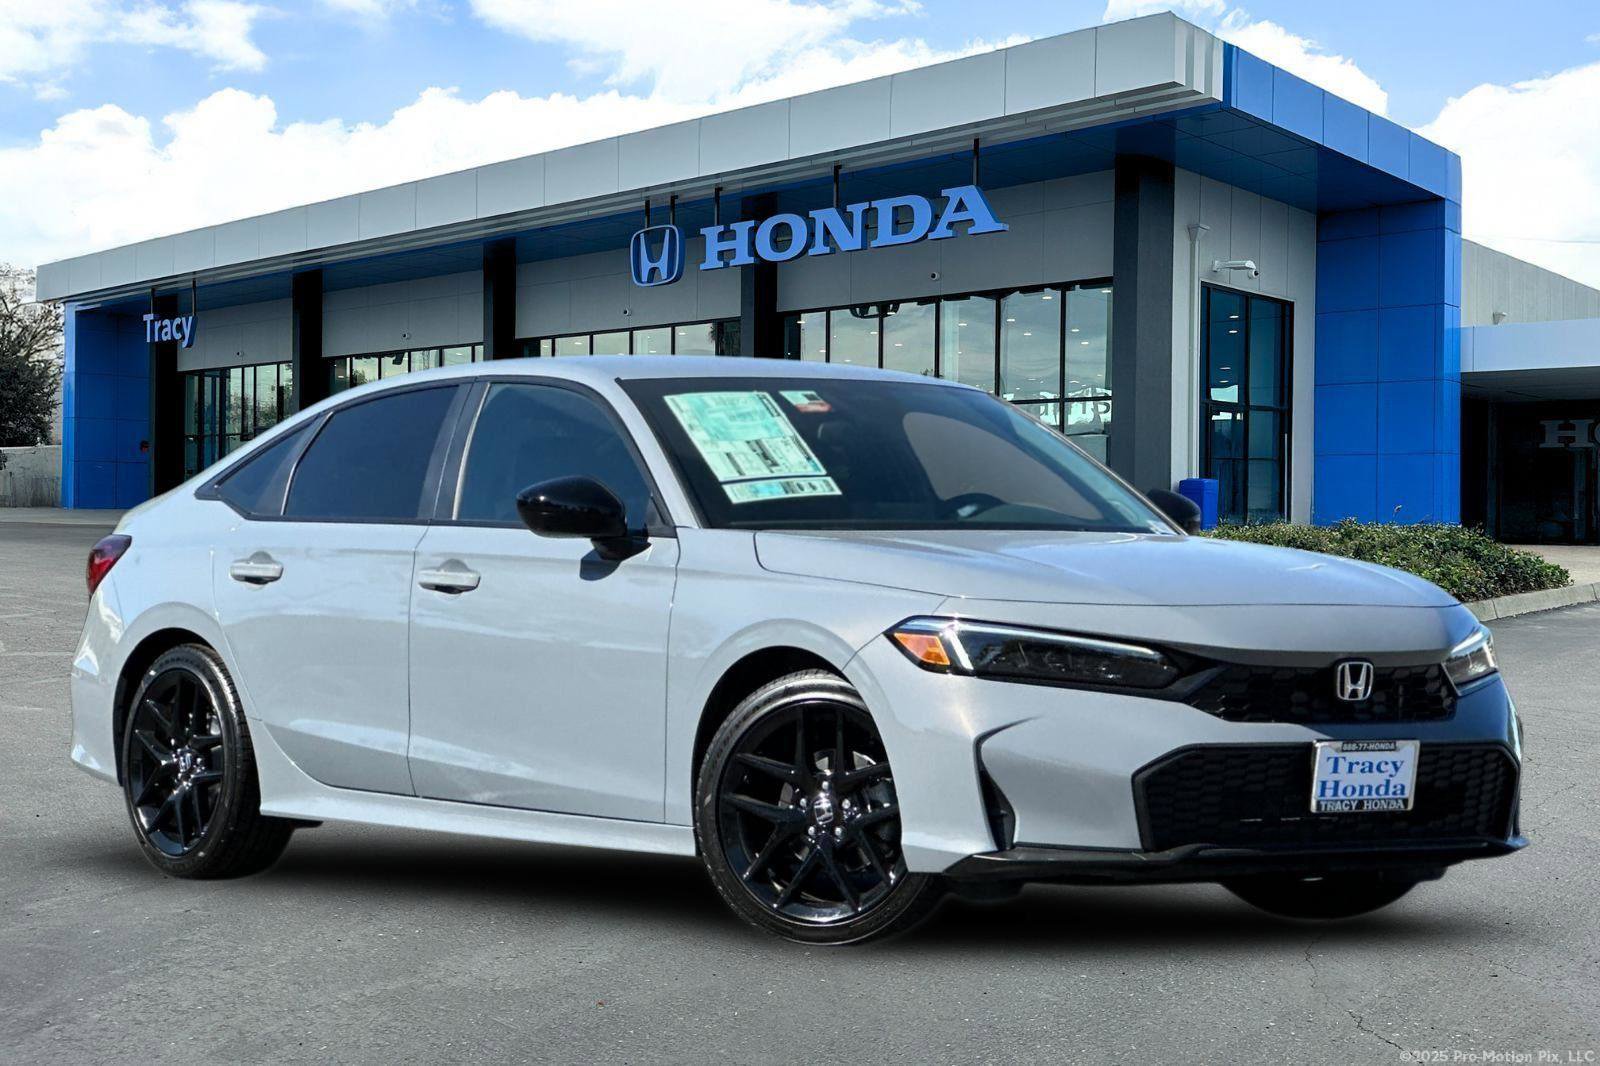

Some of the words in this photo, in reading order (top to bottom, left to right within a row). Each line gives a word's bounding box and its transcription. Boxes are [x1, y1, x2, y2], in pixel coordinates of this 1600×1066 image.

[700, 184, 1009, 271] HONDA
[143, 313, 195, 348] Tracy
[1539, 419, 1600, 448] H
[1326, 756, 1404, 777] Tracy
[1318, 778, 1406, 798] Honda
[1319, 800, 1358, 812] TRACY
[1363, 799, 1405, 811] HONDA
